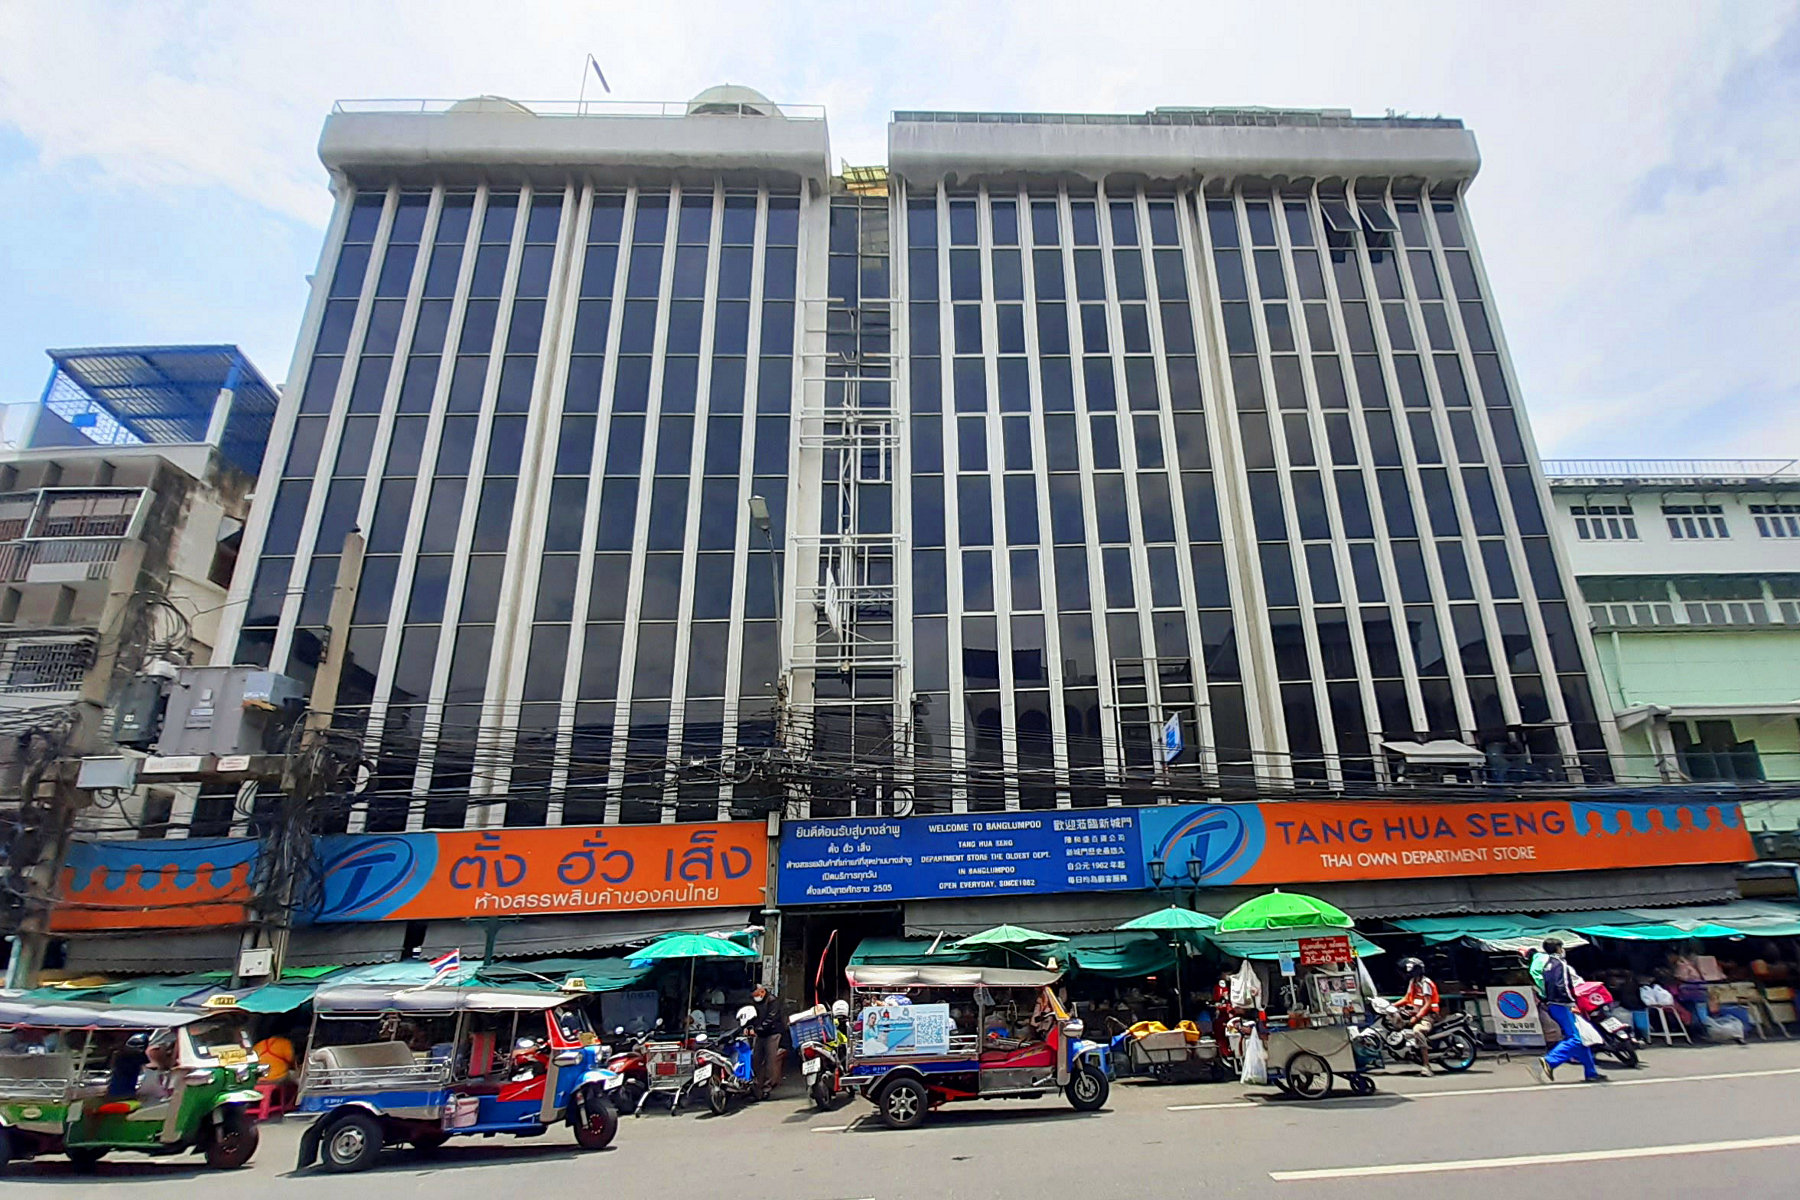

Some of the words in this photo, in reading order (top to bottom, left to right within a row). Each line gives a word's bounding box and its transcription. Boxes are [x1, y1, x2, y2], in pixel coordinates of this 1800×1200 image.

[928, 822, 969, 833] WELCOME
[972, 822, 983, 831] TO
[985, 820, 1042, 831] BANGLUMPOO
[1275, 818, 1373, 845] TANG
[1384, 816, 1456, 841] HUA
[1465, 810, 1565, 838] SENG
[450, 832, 527, 889] ตั้ง
[557, 830, 634, 885] ฮั่ว
[664, 830, 752, 881] เส็ง
[920, 854, 964, 863] DEPARTMENT
[1320, 853, 1353, 868] THAI
[1357, 851, 1398, 867] OWN
[1402, 848, 1488, 866] DEPARTMENT
[1493, 846, 1536, 861] STORE
[474, 882, 720, 911] ห้างสรรพสินค้าของคนไทย
[938, 882, 957, 890] OPEN
